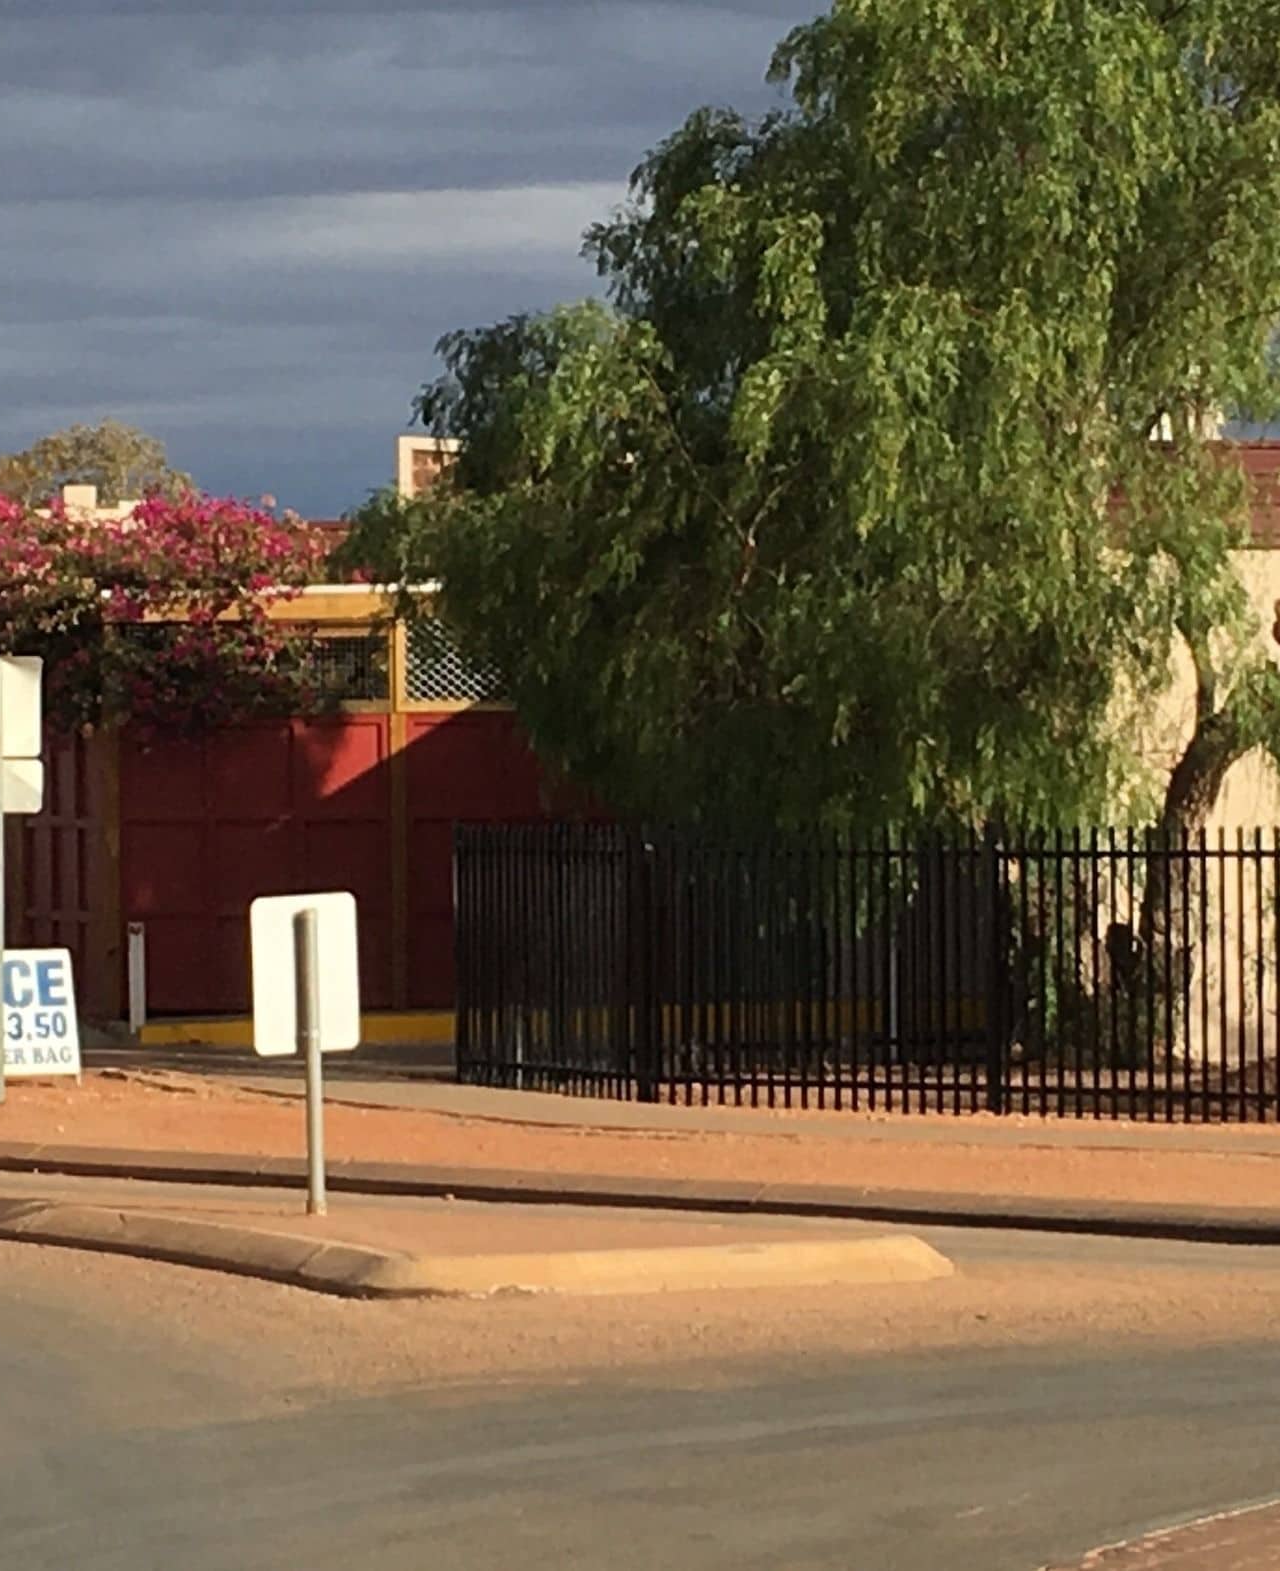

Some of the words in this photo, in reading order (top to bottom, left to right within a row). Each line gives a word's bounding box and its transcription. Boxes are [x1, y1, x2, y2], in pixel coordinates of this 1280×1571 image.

[4, 1011, 68, 1041] 3.50
[4, 1047, 26, 1064] ER
[33, 1046, 73, 1064] BAG
